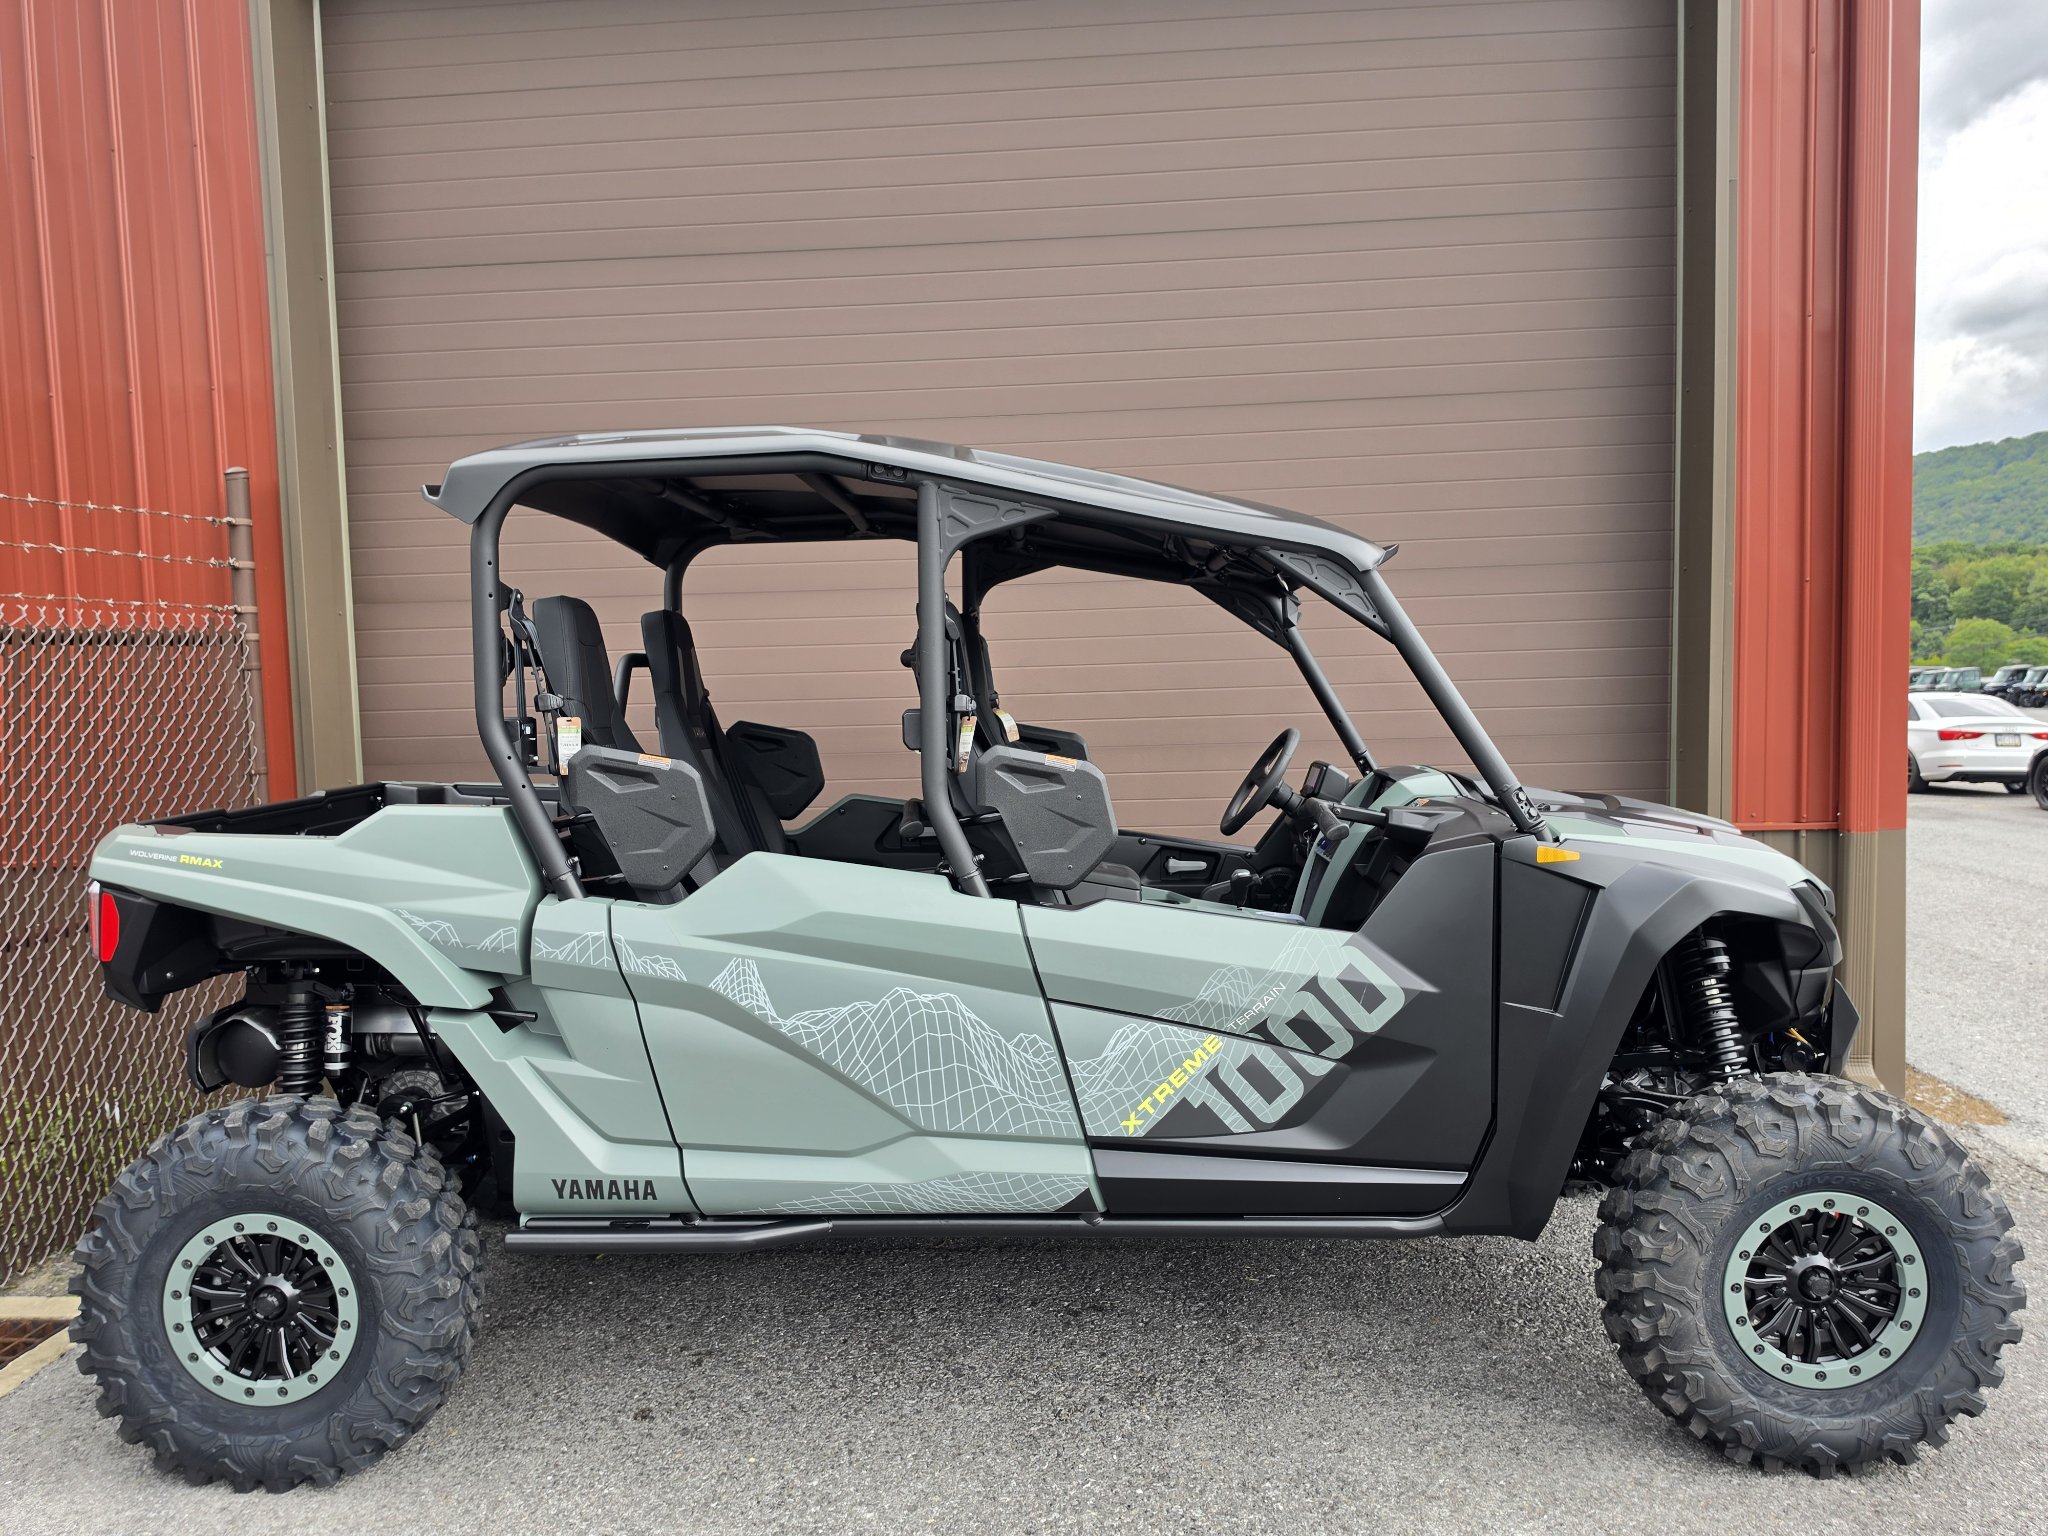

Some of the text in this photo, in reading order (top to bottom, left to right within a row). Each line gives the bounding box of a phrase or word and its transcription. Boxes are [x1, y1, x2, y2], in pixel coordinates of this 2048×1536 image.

[129, 849, 223, 869] WOLVERINE RMAX
[1226, 982, 1286, 1030] TERRAIN
[1183, 945, 1405, 1134] 1000
[551, 1179, 658, 1201] YAMAHA
